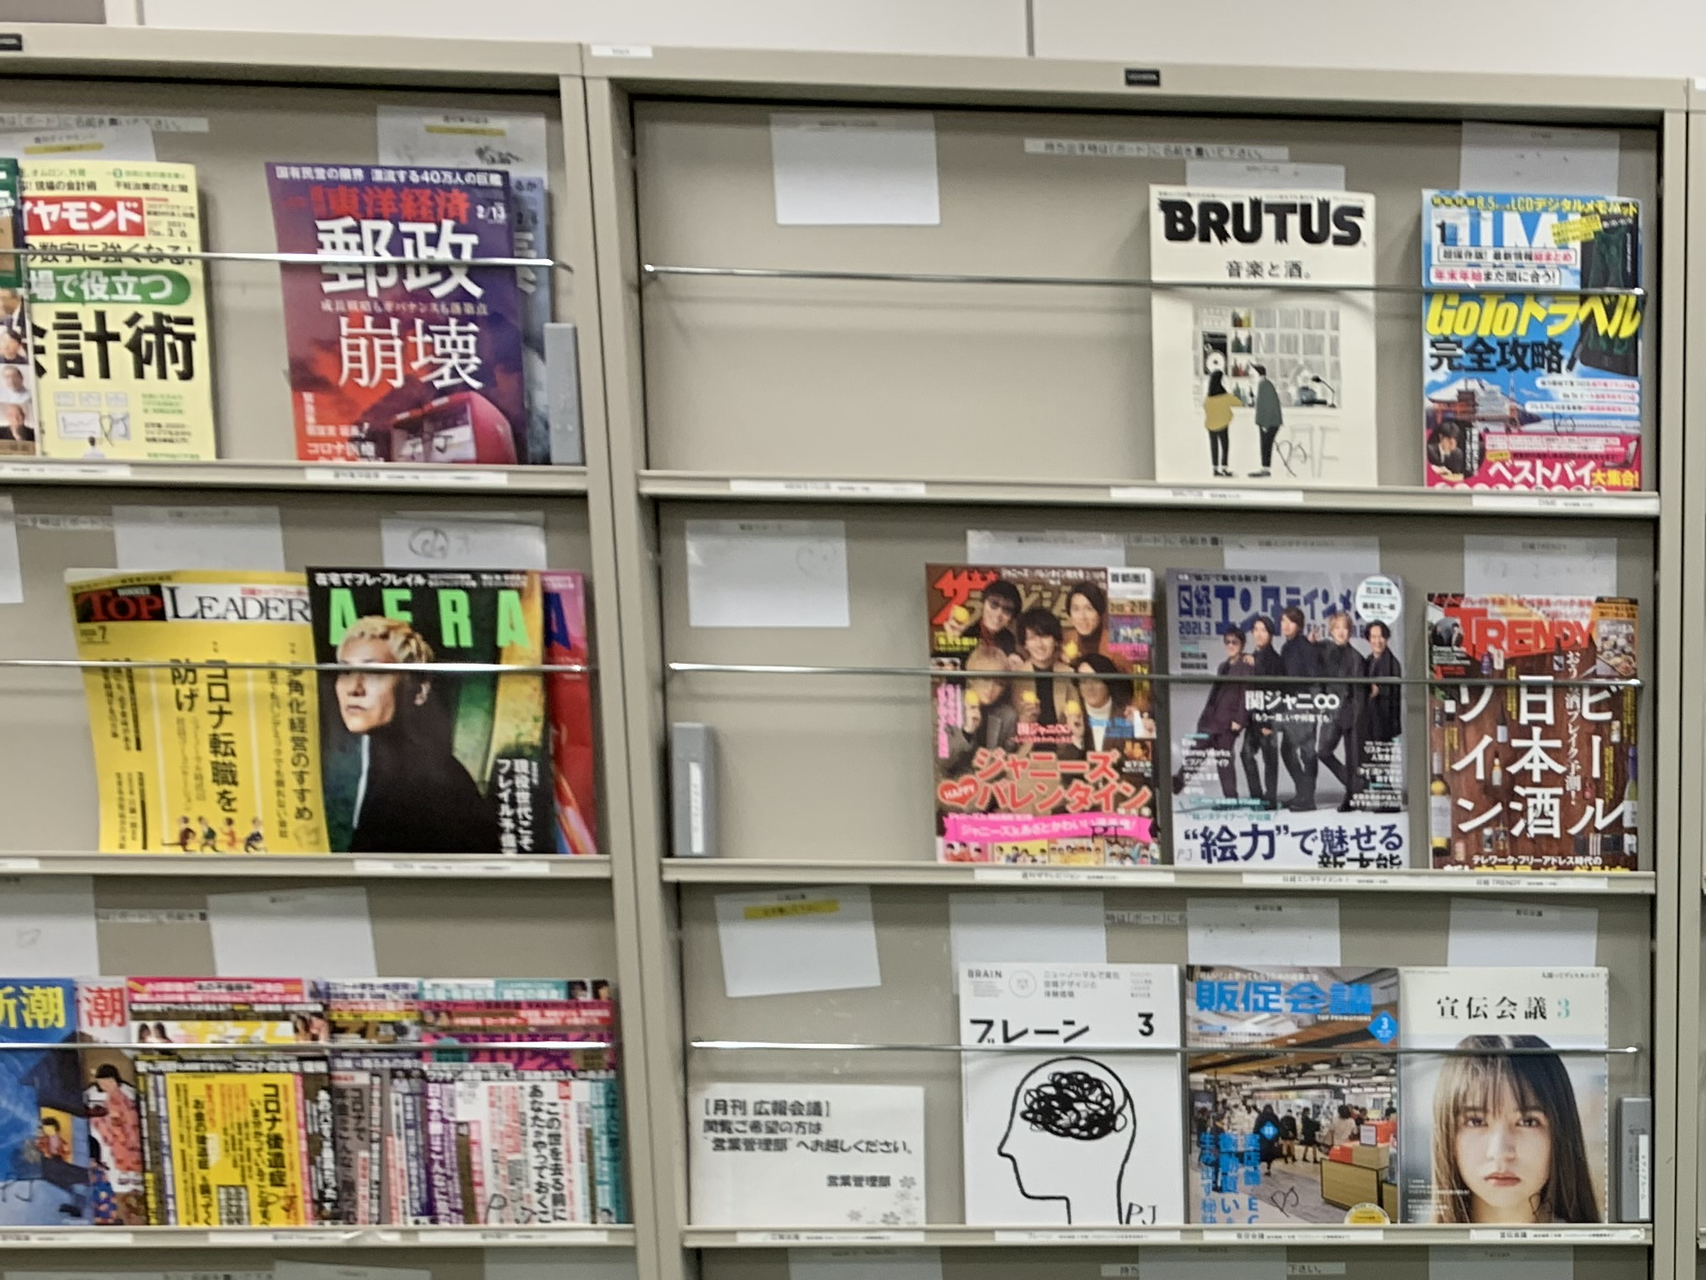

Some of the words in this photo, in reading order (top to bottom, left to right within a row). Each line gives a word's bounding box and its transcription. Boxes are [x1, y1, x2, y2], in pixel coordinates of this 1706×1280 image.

[1158, 197, 1365, 246] BRUTUS
[316, 216, 483, 299] 郵政
[1226, 260, 1310, 278] 音楽と酒。
[1426, 294, 1640, 339] GoToトラベル
[338, 315, 484, 390] 崩壊
[1429, 340, 1564, 374] 完全攻略
[1488, 461, 1598, 486] ベストバイ
[1591, 471, 1639, 488] 大集合!
[76, 590, 163, 621] TOP
[165, 587, 311, 621] LEADER
[329, 588, 530, 648] AERA
[1177, 585, 1212, 617] 日経
[99, 626, 107, 639] 7
[1444, 606, 1596, 660] TRENDY
[1245, 690, 1340, 711] 関ジャニ∞
[972, 747, 1122, 784] ジャニーズ
[1506, 675, 1567, 839] 日本酒
[1567, 684, 1625, 835] ビール
[978, 779, 1151, 813] バレンタイン
[967, 968, 1002, 979] BRAIN
[1196, 980, 1373, 1015] 販促会議
[1436, 996, 1548, 1020] 宣伝会議
[1556, 998, 1571, 1018] 3
[969, 1019, 1090, 1044] ブレーン
[1137, 1012, 1154, 1037] 3
[1381, 1017, 1388, 1028] 3
[703, 1120, 822, 1135] 閲覧ご希望の方は
[826, 1175, 891, 1188] 営業管理部
[1126, 1203, 1158, 1225] PJ
